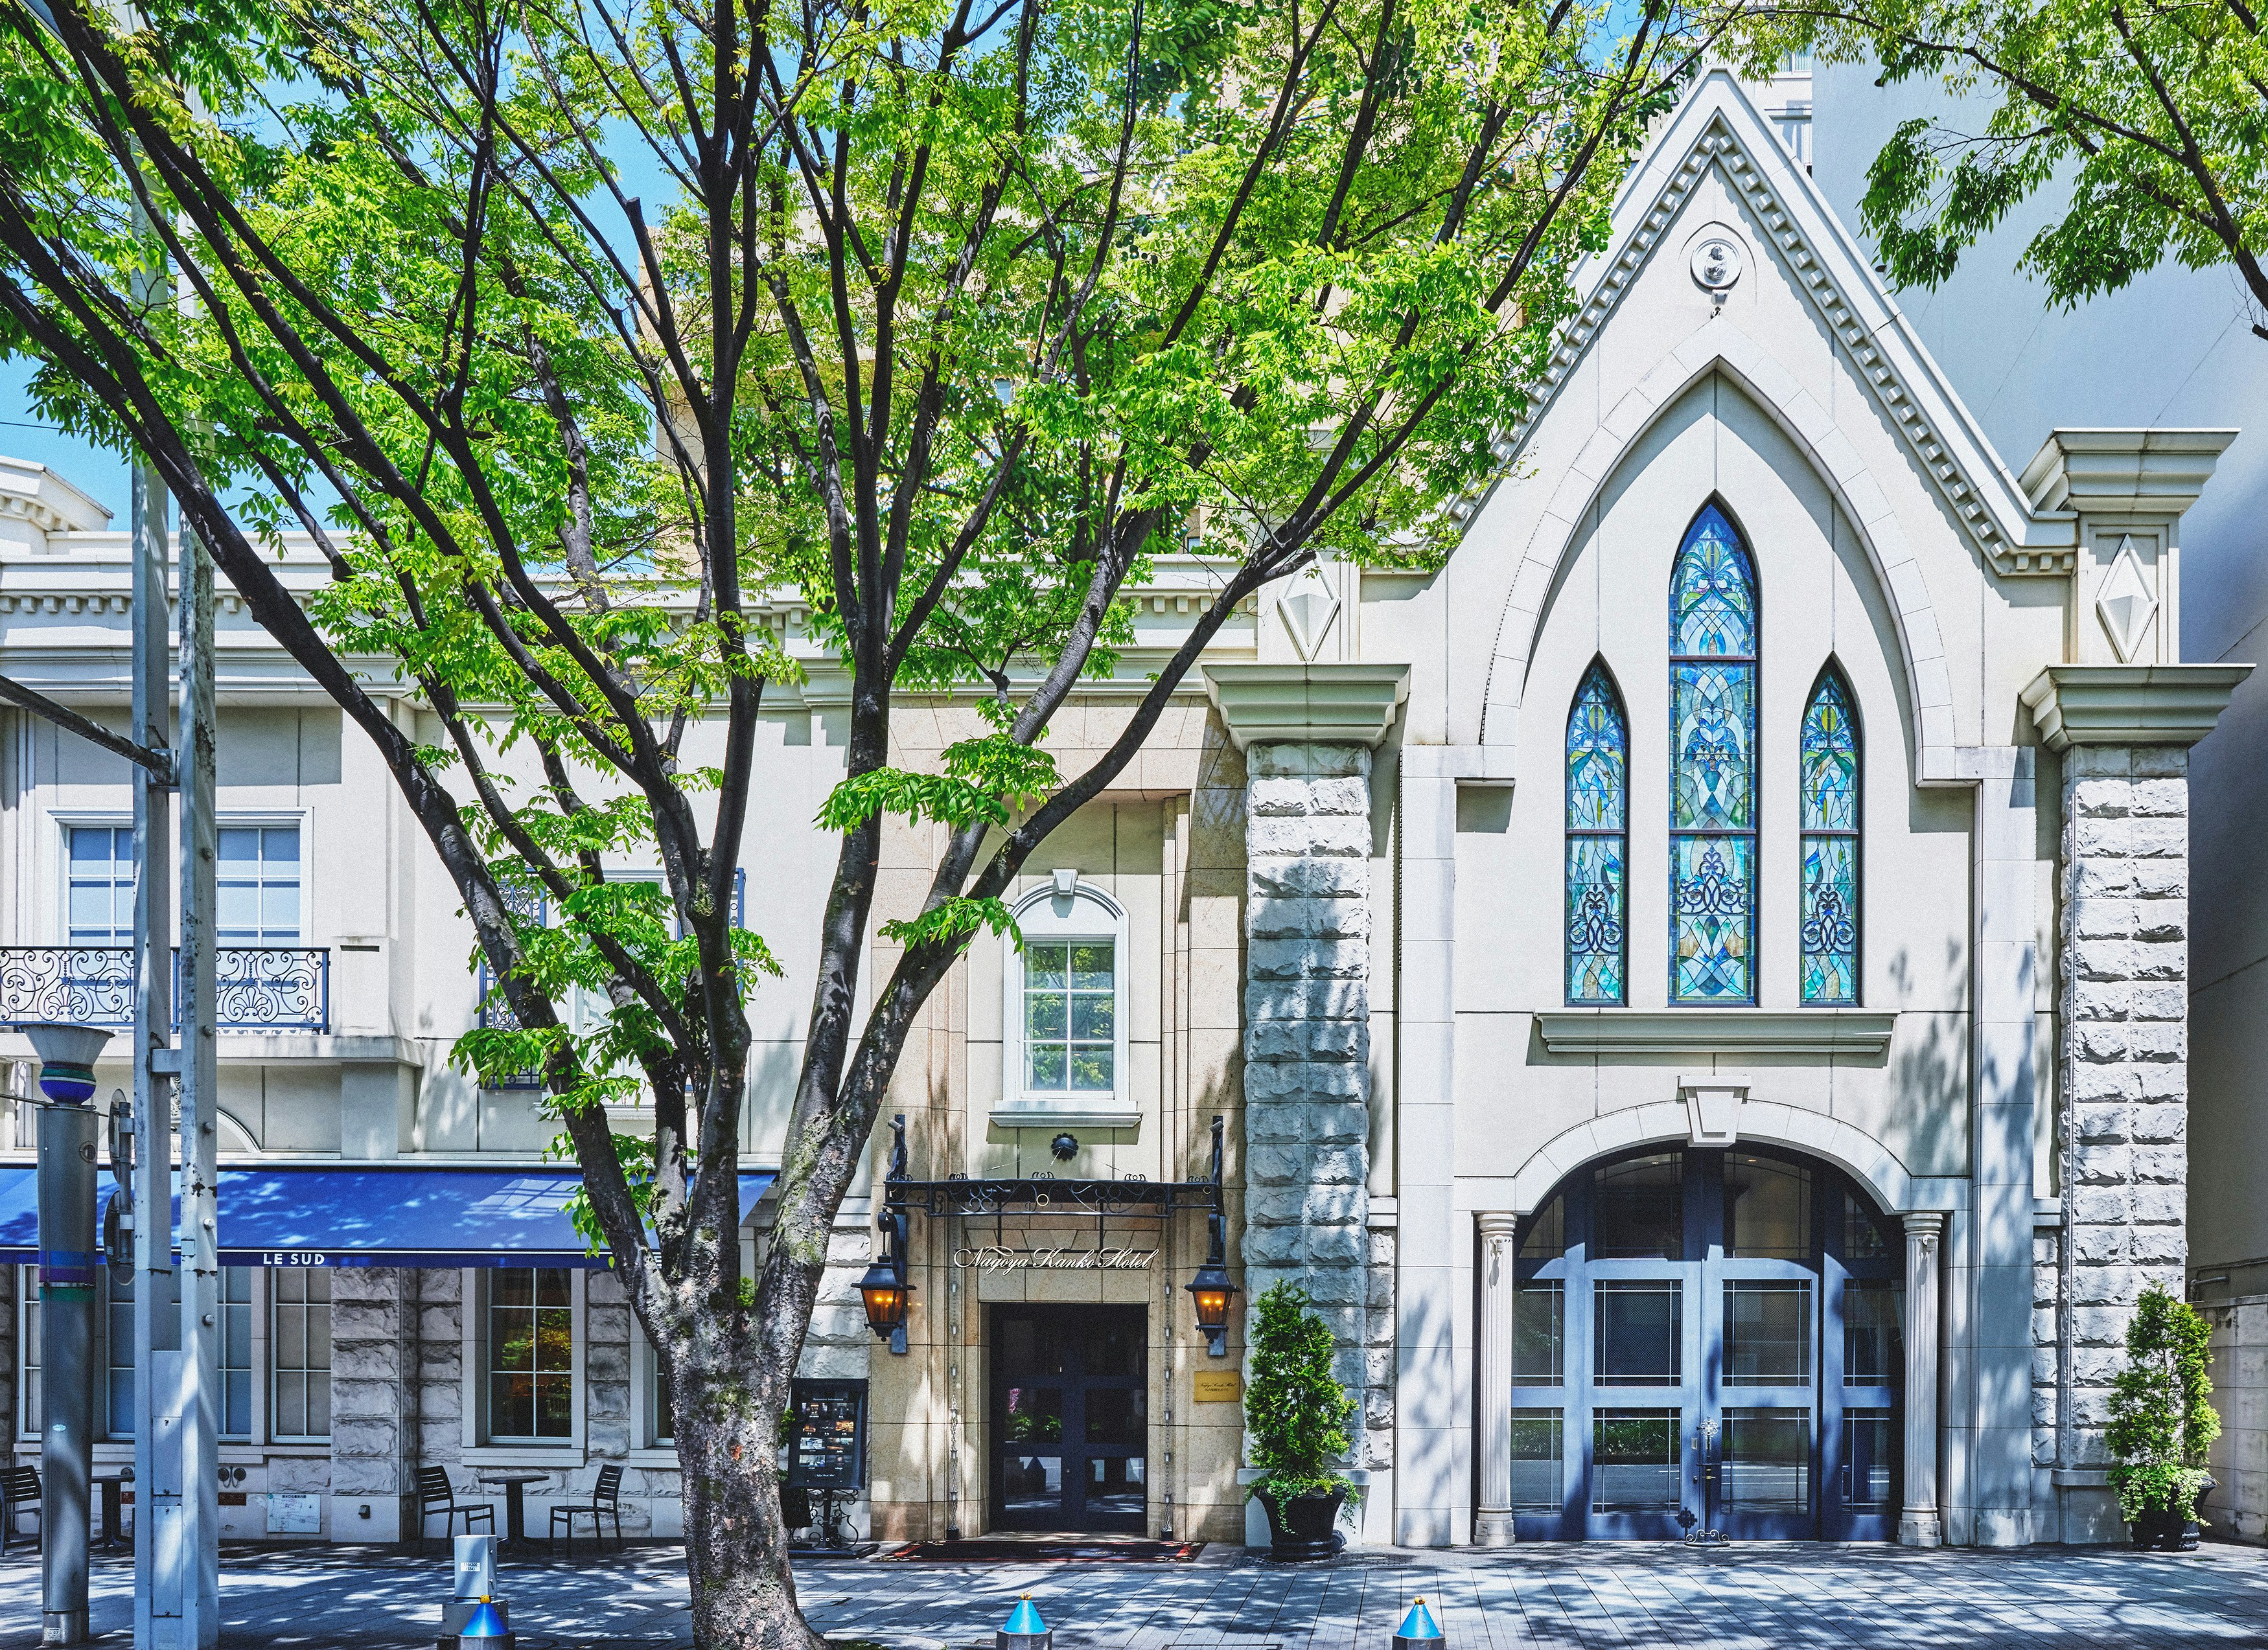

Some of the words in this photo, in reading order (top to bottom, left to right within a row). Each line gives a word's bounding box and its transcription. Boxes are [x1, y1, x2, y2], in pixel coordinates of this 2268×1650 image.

[263, 1253, 283, 1265] LE
[290, 1253, 325, 1265] SUD
[953, 1246, 1029, 1276] Nagoya
[1032, 1247, 1095, 1268] Kanko
[1098, 1246, 1160, 1268] Hotel
